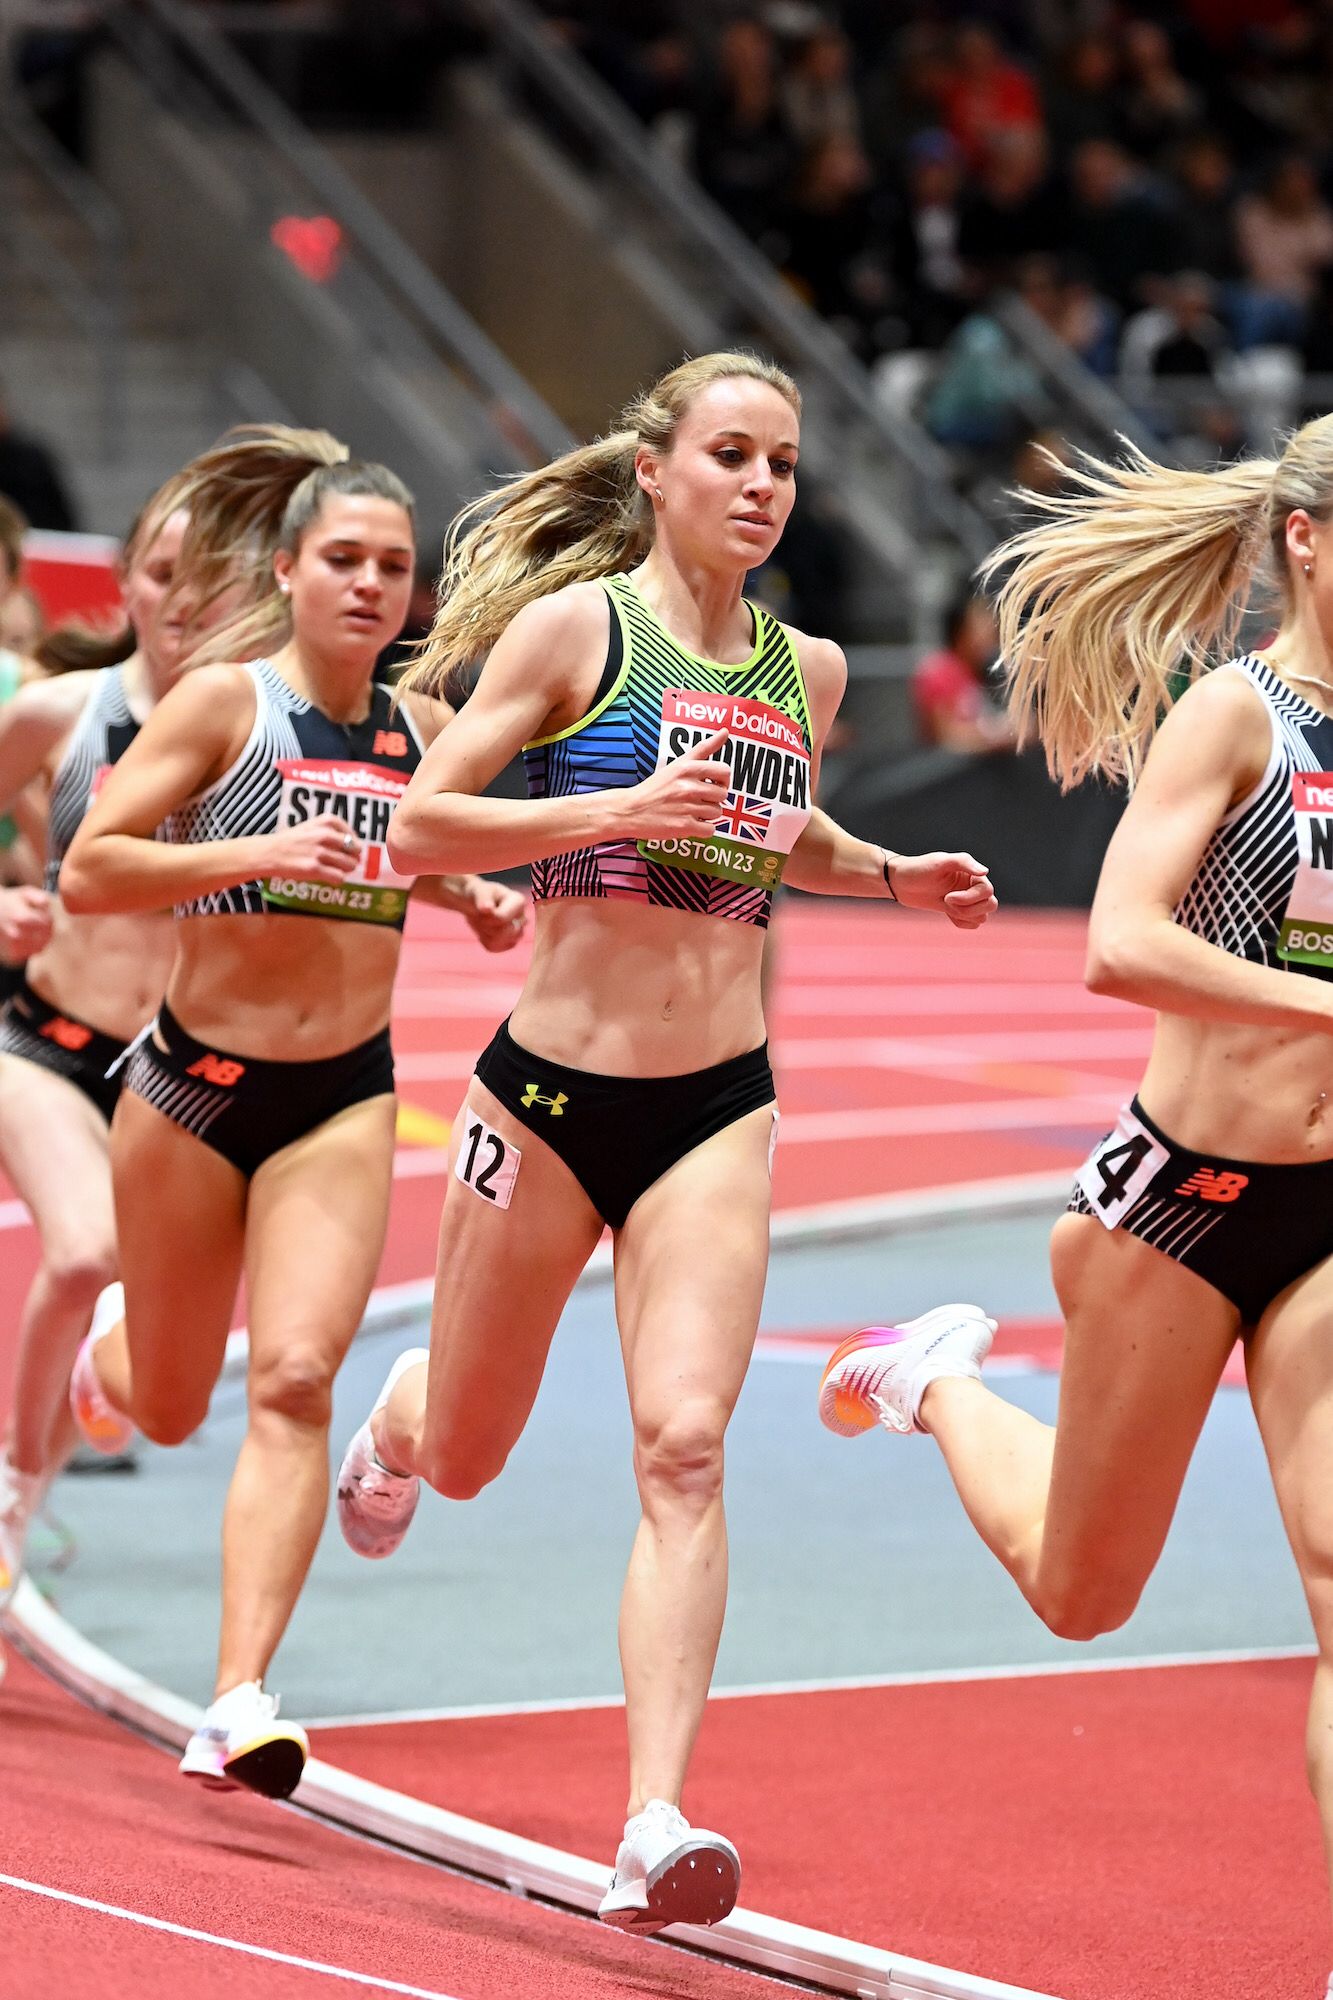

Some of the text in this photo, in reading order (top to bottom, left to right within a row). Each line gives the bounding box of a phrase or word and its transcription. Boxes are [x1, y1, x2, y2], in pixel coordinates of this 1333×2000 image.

[675, 700, 802, 749] new balance
[287, 787, 397, 843] STAEH
[732, 852, 755, 873] 23
[269, 877, 347, 906] BOSTON
[347, 890, 372, 910] 23
[1288, 929, 1333, 954] BOS
[186, 1053, 245, 1086] NB
[463, 1123, 505, 1200] 12
[1096, 1134, 1153, 1210] 4
[1175, 1167, 1249, 1203] NB
